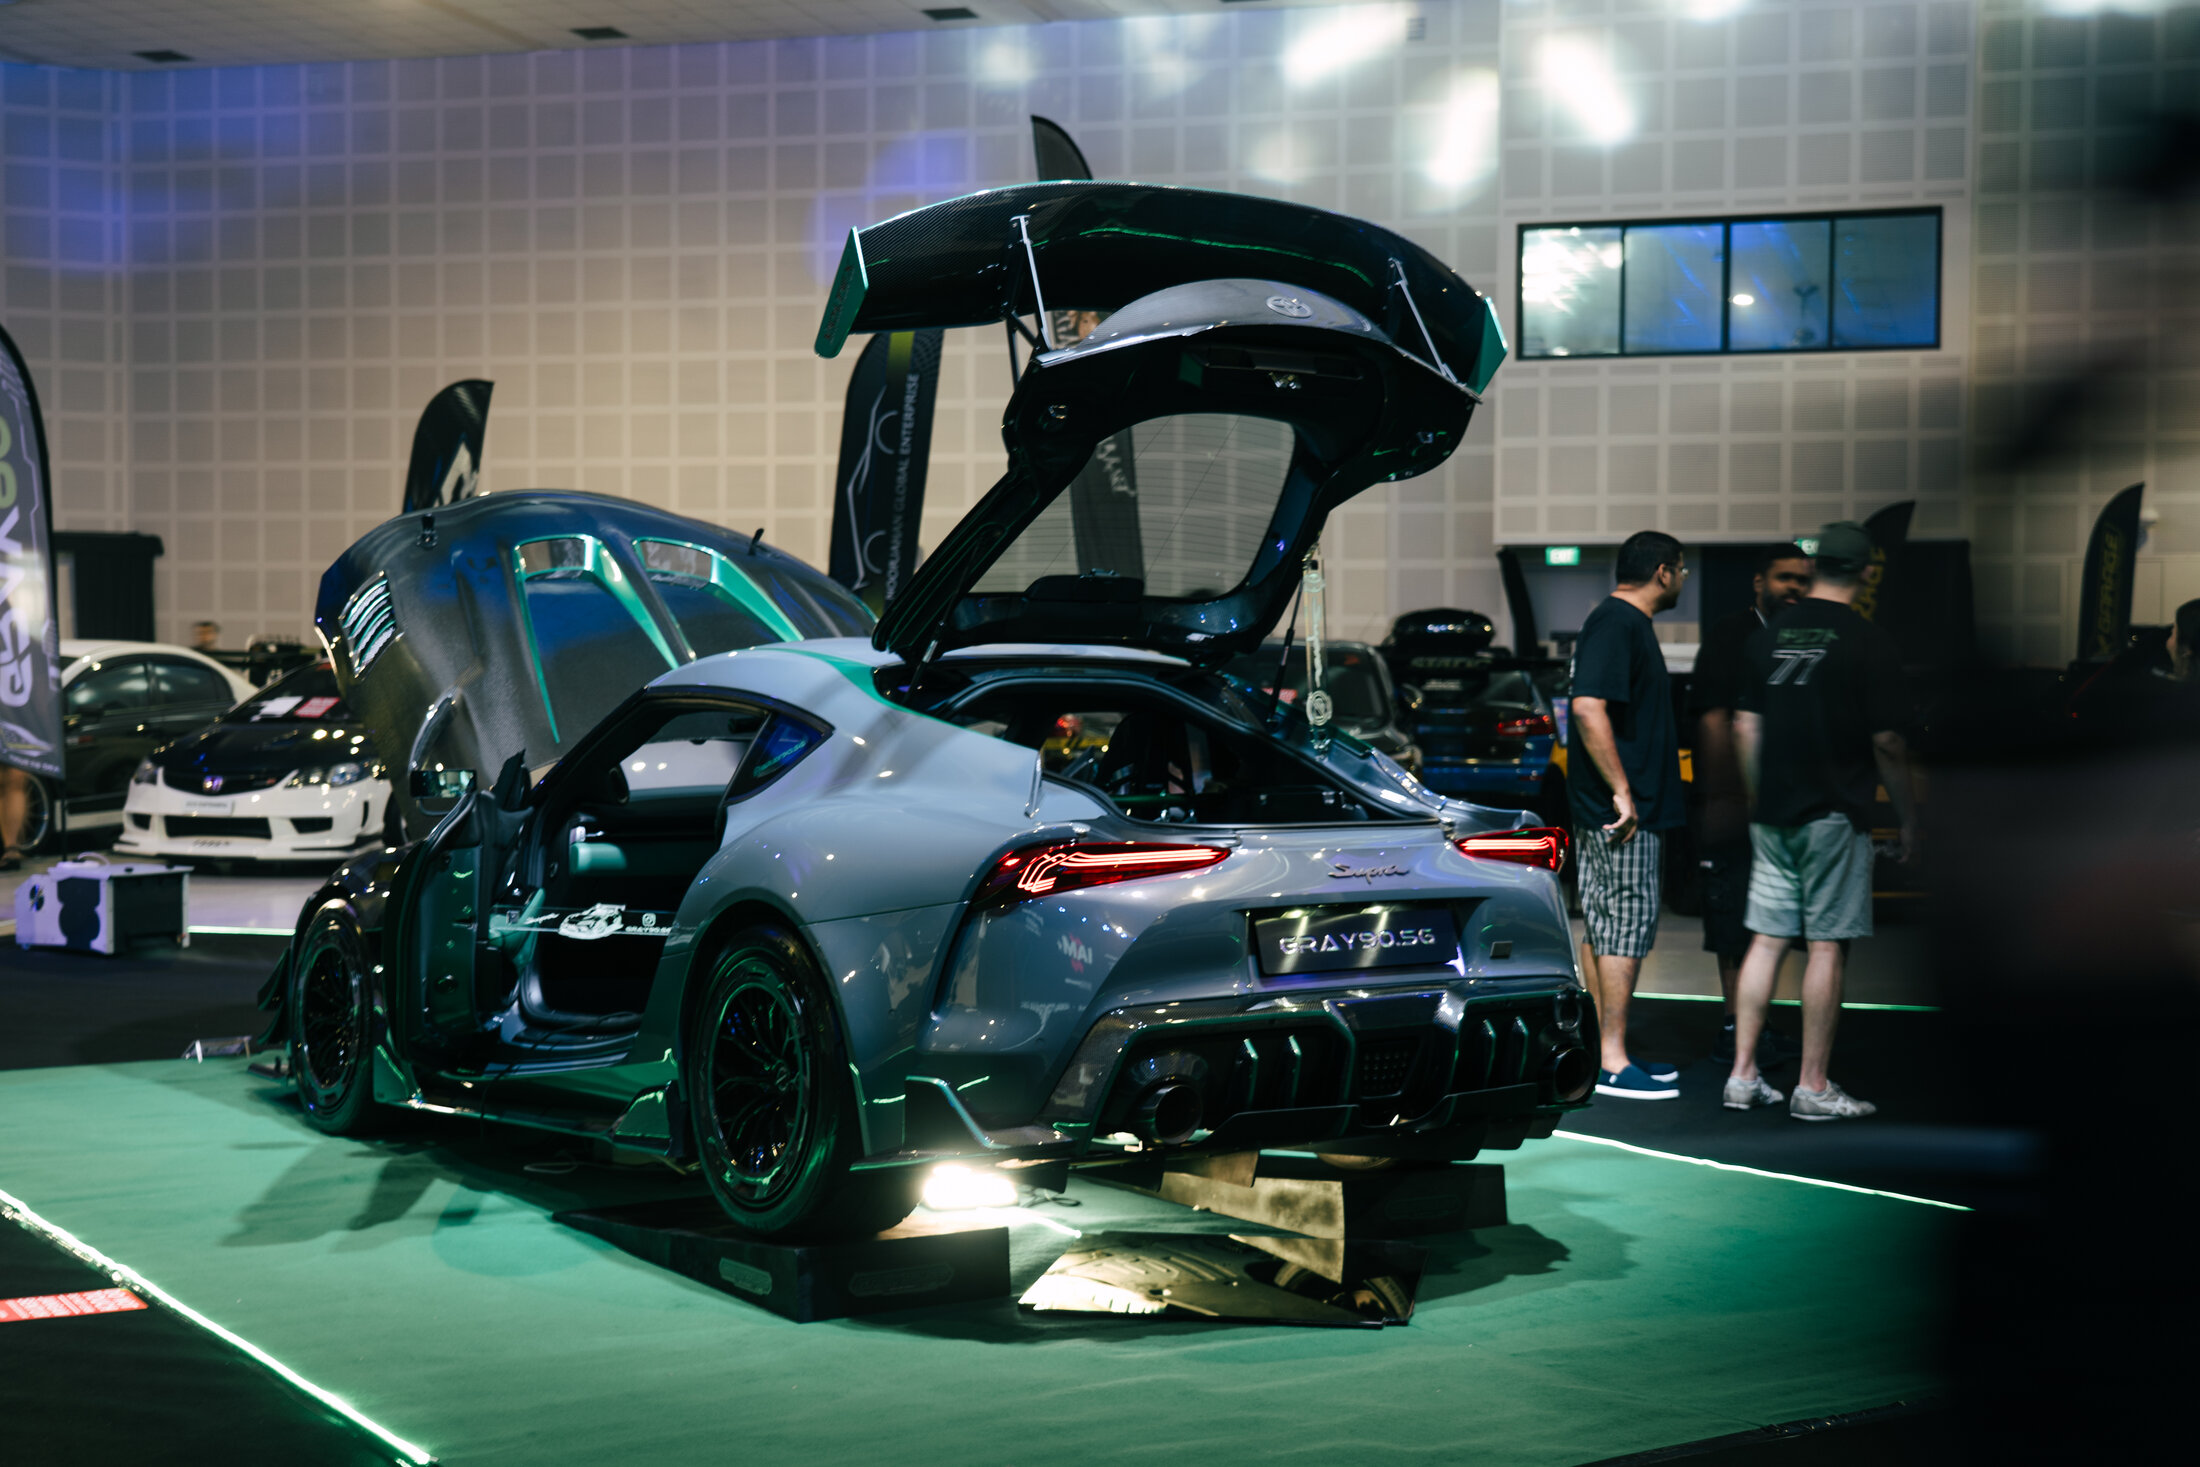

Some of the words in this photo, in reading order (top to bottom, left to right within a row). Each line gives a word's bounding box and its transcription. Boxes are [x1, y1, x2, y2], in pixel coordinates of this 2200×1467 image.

[899, 373, 920, 455] ENTERPRISE
[893, 457, 910, 511] GLOBAL
[886, 514, 904, 600] NOORJAHAN
[1549, 549, 1574, 565] EXIT
[1766, 649, 1827, 686] 77
[1328, 864, 1410, 885] Supra
